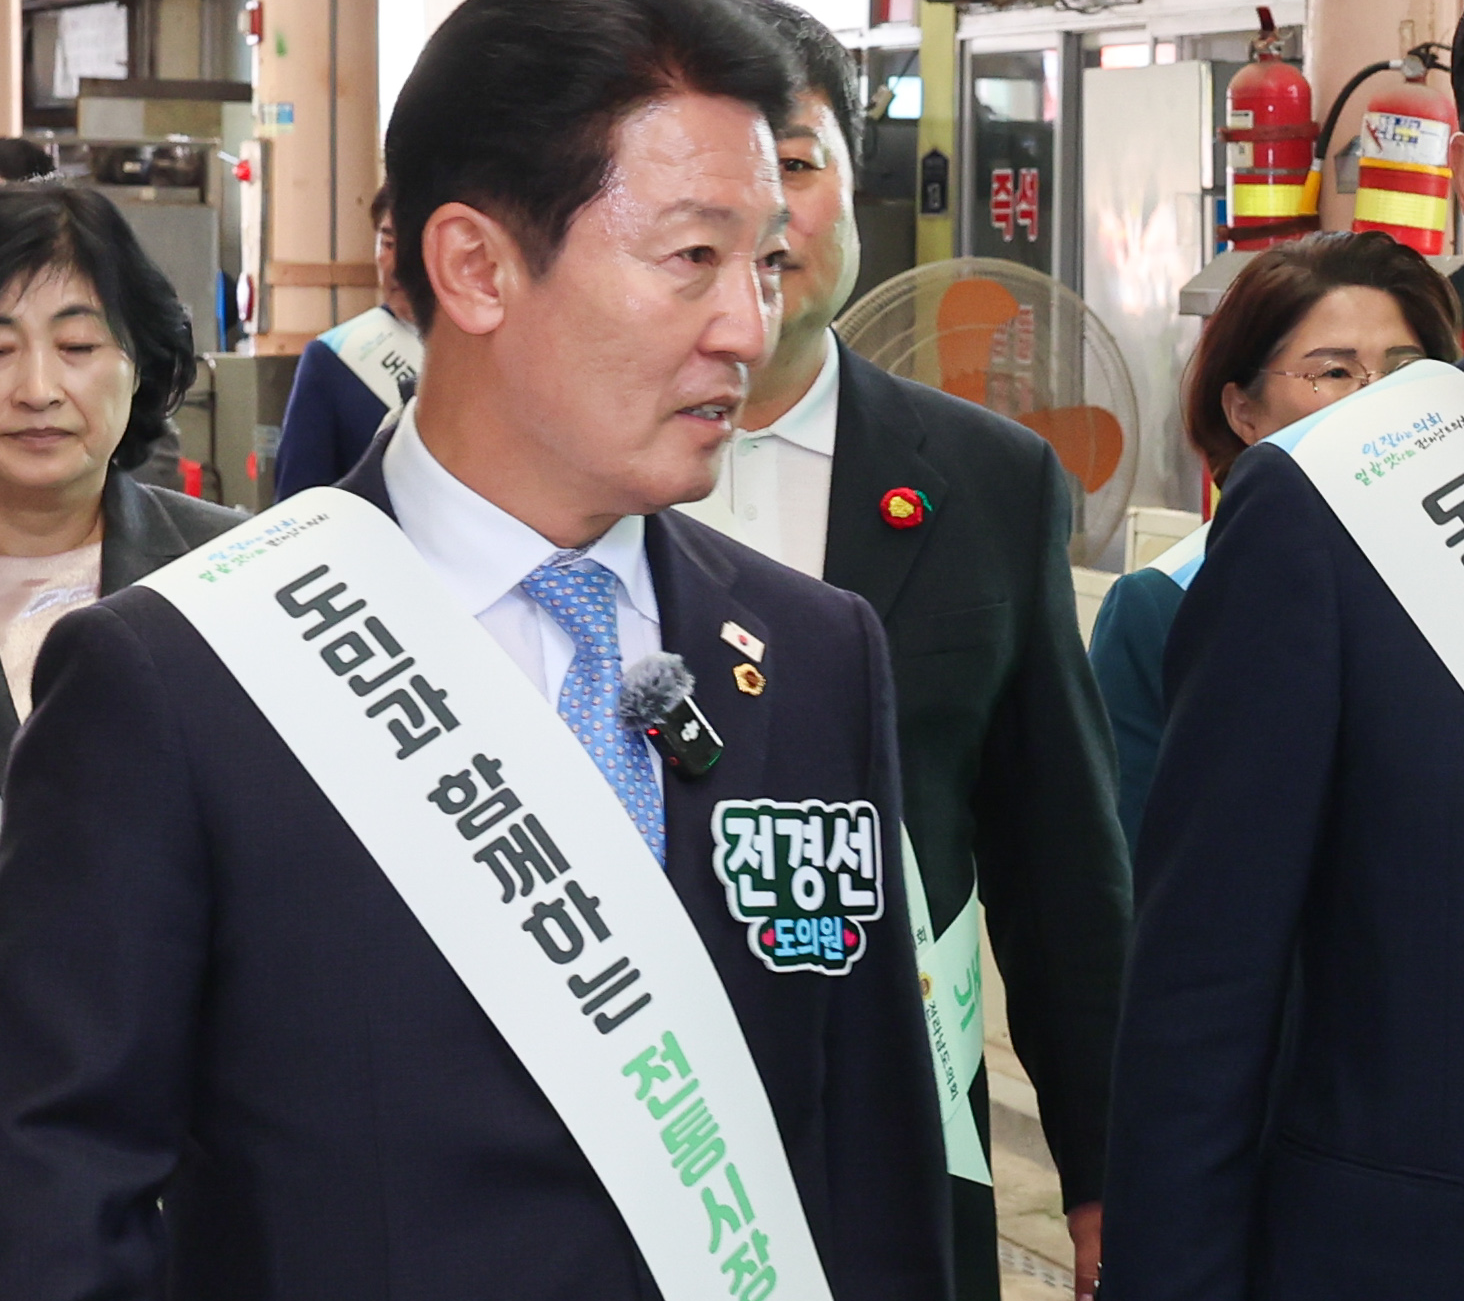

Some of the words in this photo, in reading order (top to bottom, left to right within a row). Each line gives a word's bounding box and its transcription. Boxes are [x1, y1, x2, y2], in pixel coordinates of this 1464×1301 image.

[990, 167, 1040, 242] 즉석
[275, 563, 456, 759] 도민과
[427, 752, 652, 1035] 함께하는
[725, 814, 876, 911] 전경선
[774, 916, 845, 961] 도의원
[925, 998, 961, 1103] 전라남도의회
